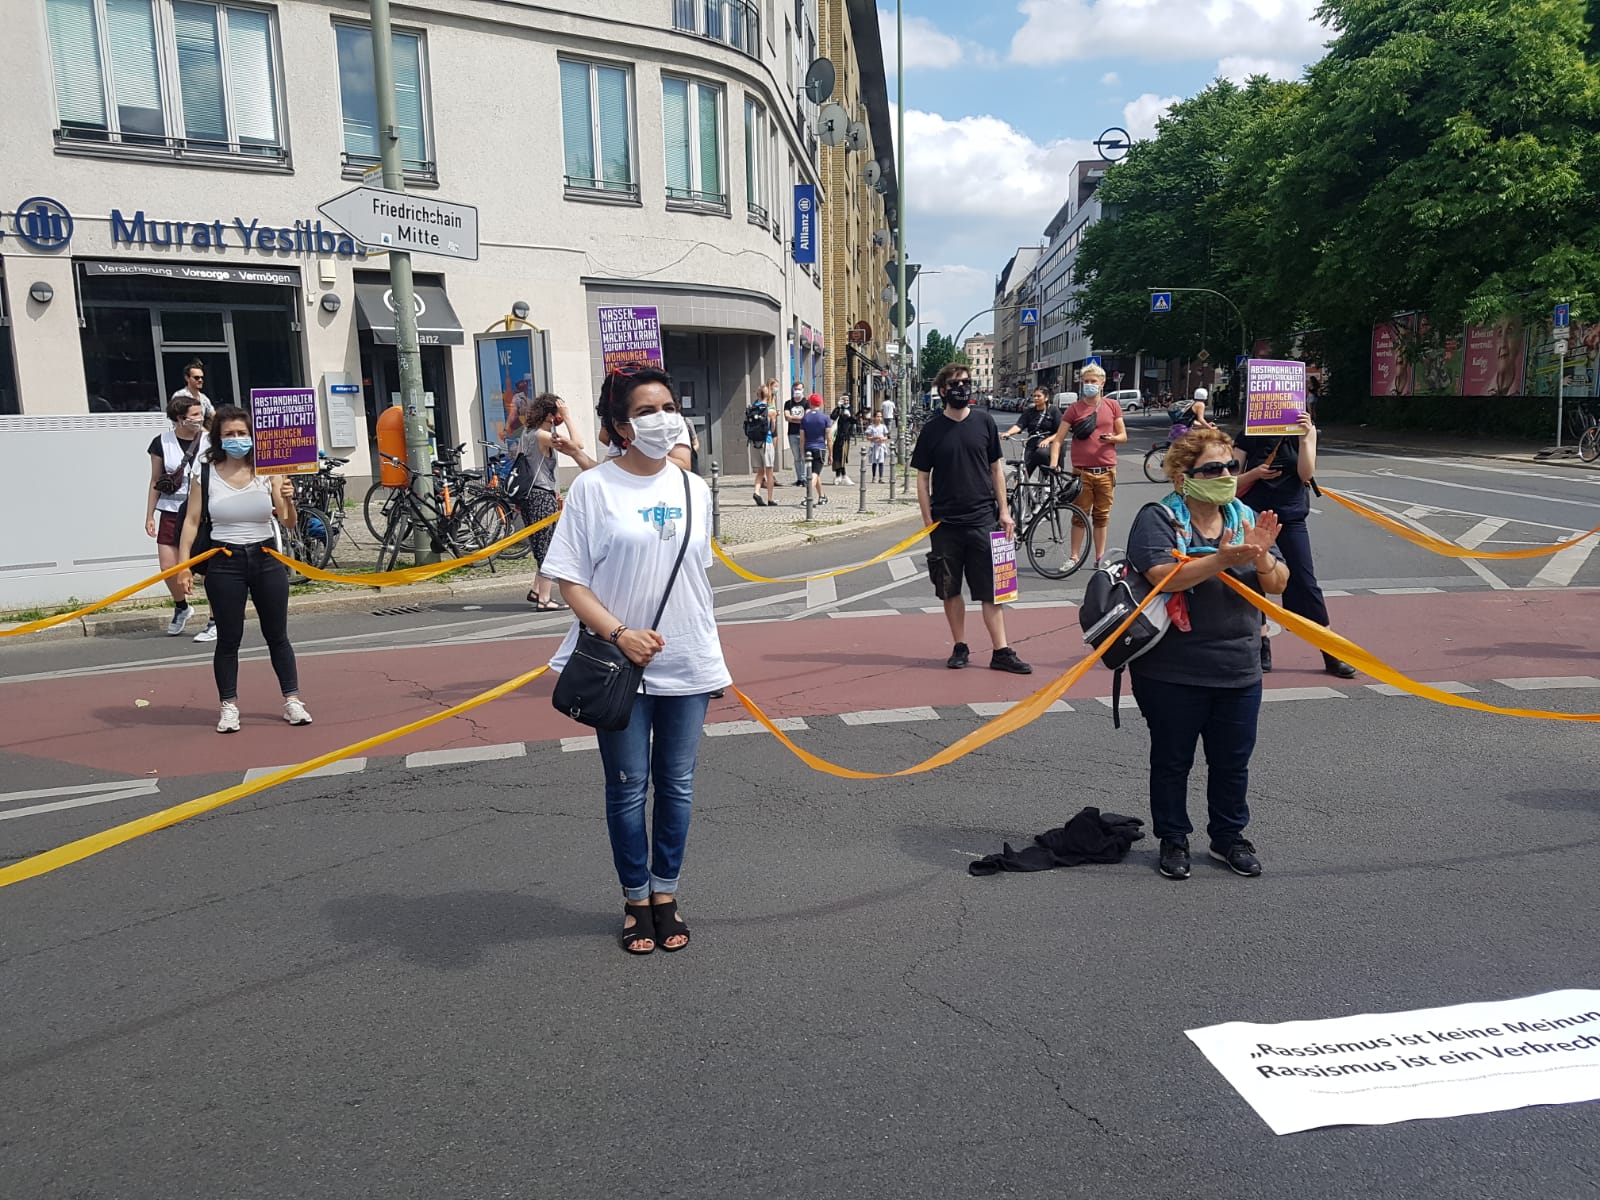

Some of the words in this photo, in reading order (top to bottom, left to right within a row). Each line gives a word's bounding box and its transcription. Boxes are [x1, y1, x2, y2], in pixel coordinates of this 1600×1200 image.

[111, 209, 227, 248] Murat
[800, 213, 809, 250] Allianz
[398, 225, 440, 246] Mitte
[99, 264, 173, 276] Versicherung
[181, 268, 230, 280] Vorsorge
[239, 270, 291, 284] Vermögen
[603, 331, 632, 343] MACHEN
[634, 330, 658, 341] KRANK
[604, 342, 626, 352] SOFORT
[500, 350, 513, 365] WE
[605, 350, 647, 362] WOHNUNGEN
[1250, 366, 1303, 374] ABSTANDHALTEN
[1250, 381, 1273, 391] GEHT
[1275, 380, 1303, 392] NICHT!
[254, 394, 313, 407] ABSTANDHALTEN
[1250, 392, 1292, 402] WOHNUNGEN
[255, 407, 262, 415] IM
[1250, 402, 1263, 410] UND
[1266, 401, 1304, 410] GESUNDHEIT
[256, 415, 280, 428] GEHT
[283, 412, 314, 426] NICHT!
[1264, 410, 1282, 419] ALLE!
[256, 427, 302, 440] WOHNUNGEN
[256, 440, 271, 450] UND
[274, 436, 315, 448] GESUNDHEIT
[274, 448, 292, 458] ALLE!
[1390, 1033, 1430, 1046] ist
[1427, 1027, 1504, 1042] keine
[1502, 1011, 1600, 1034] Meinun
[1256, 1060, 1397, 1078] Rassismus
[1396, 1055, 1437, 1068] ist
[1439, 1051, 1484, 1064] ein
[1479, 1034, 1600, 1058] Verbrech
